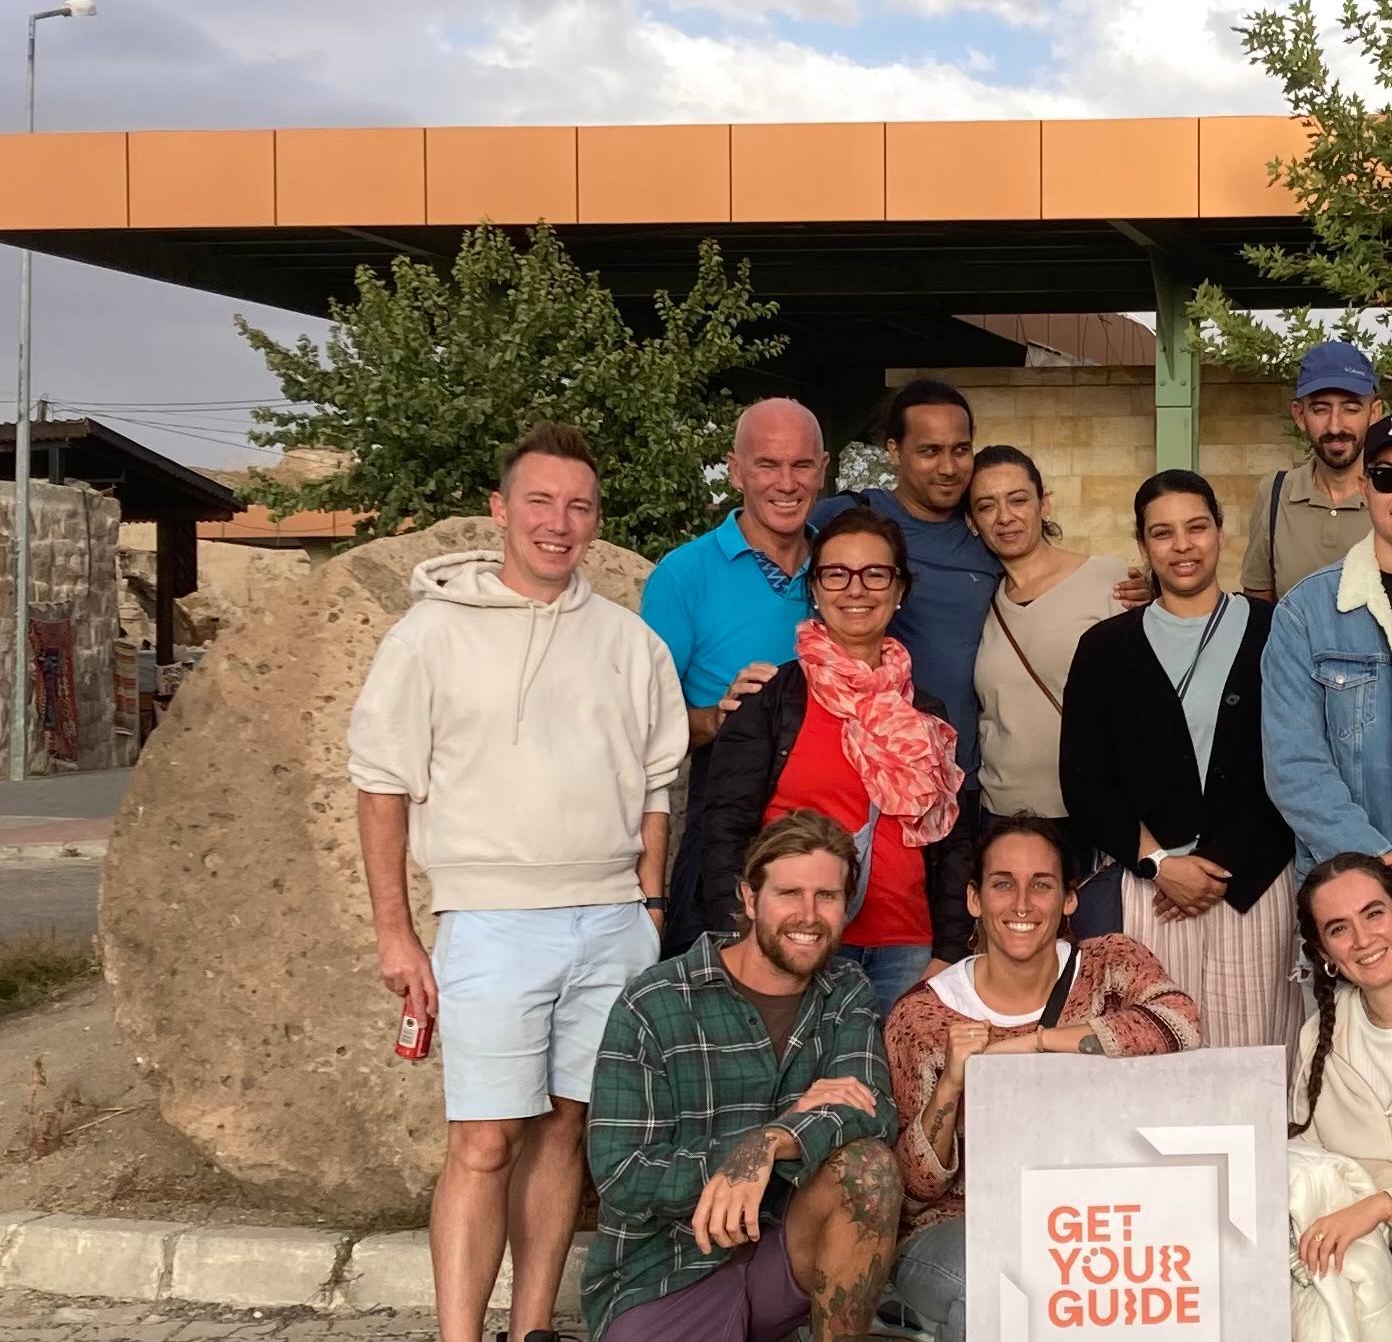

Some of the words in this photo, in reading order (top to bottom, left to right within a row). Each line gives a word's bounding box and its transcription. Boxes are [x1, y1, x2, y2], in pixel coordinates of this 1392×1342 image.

[1047, 1204, 1141, 1244] GET
[1047, 1245, 1193, 1286] YOUR
[1047, 1286, 1201, 1329] GUIDE
